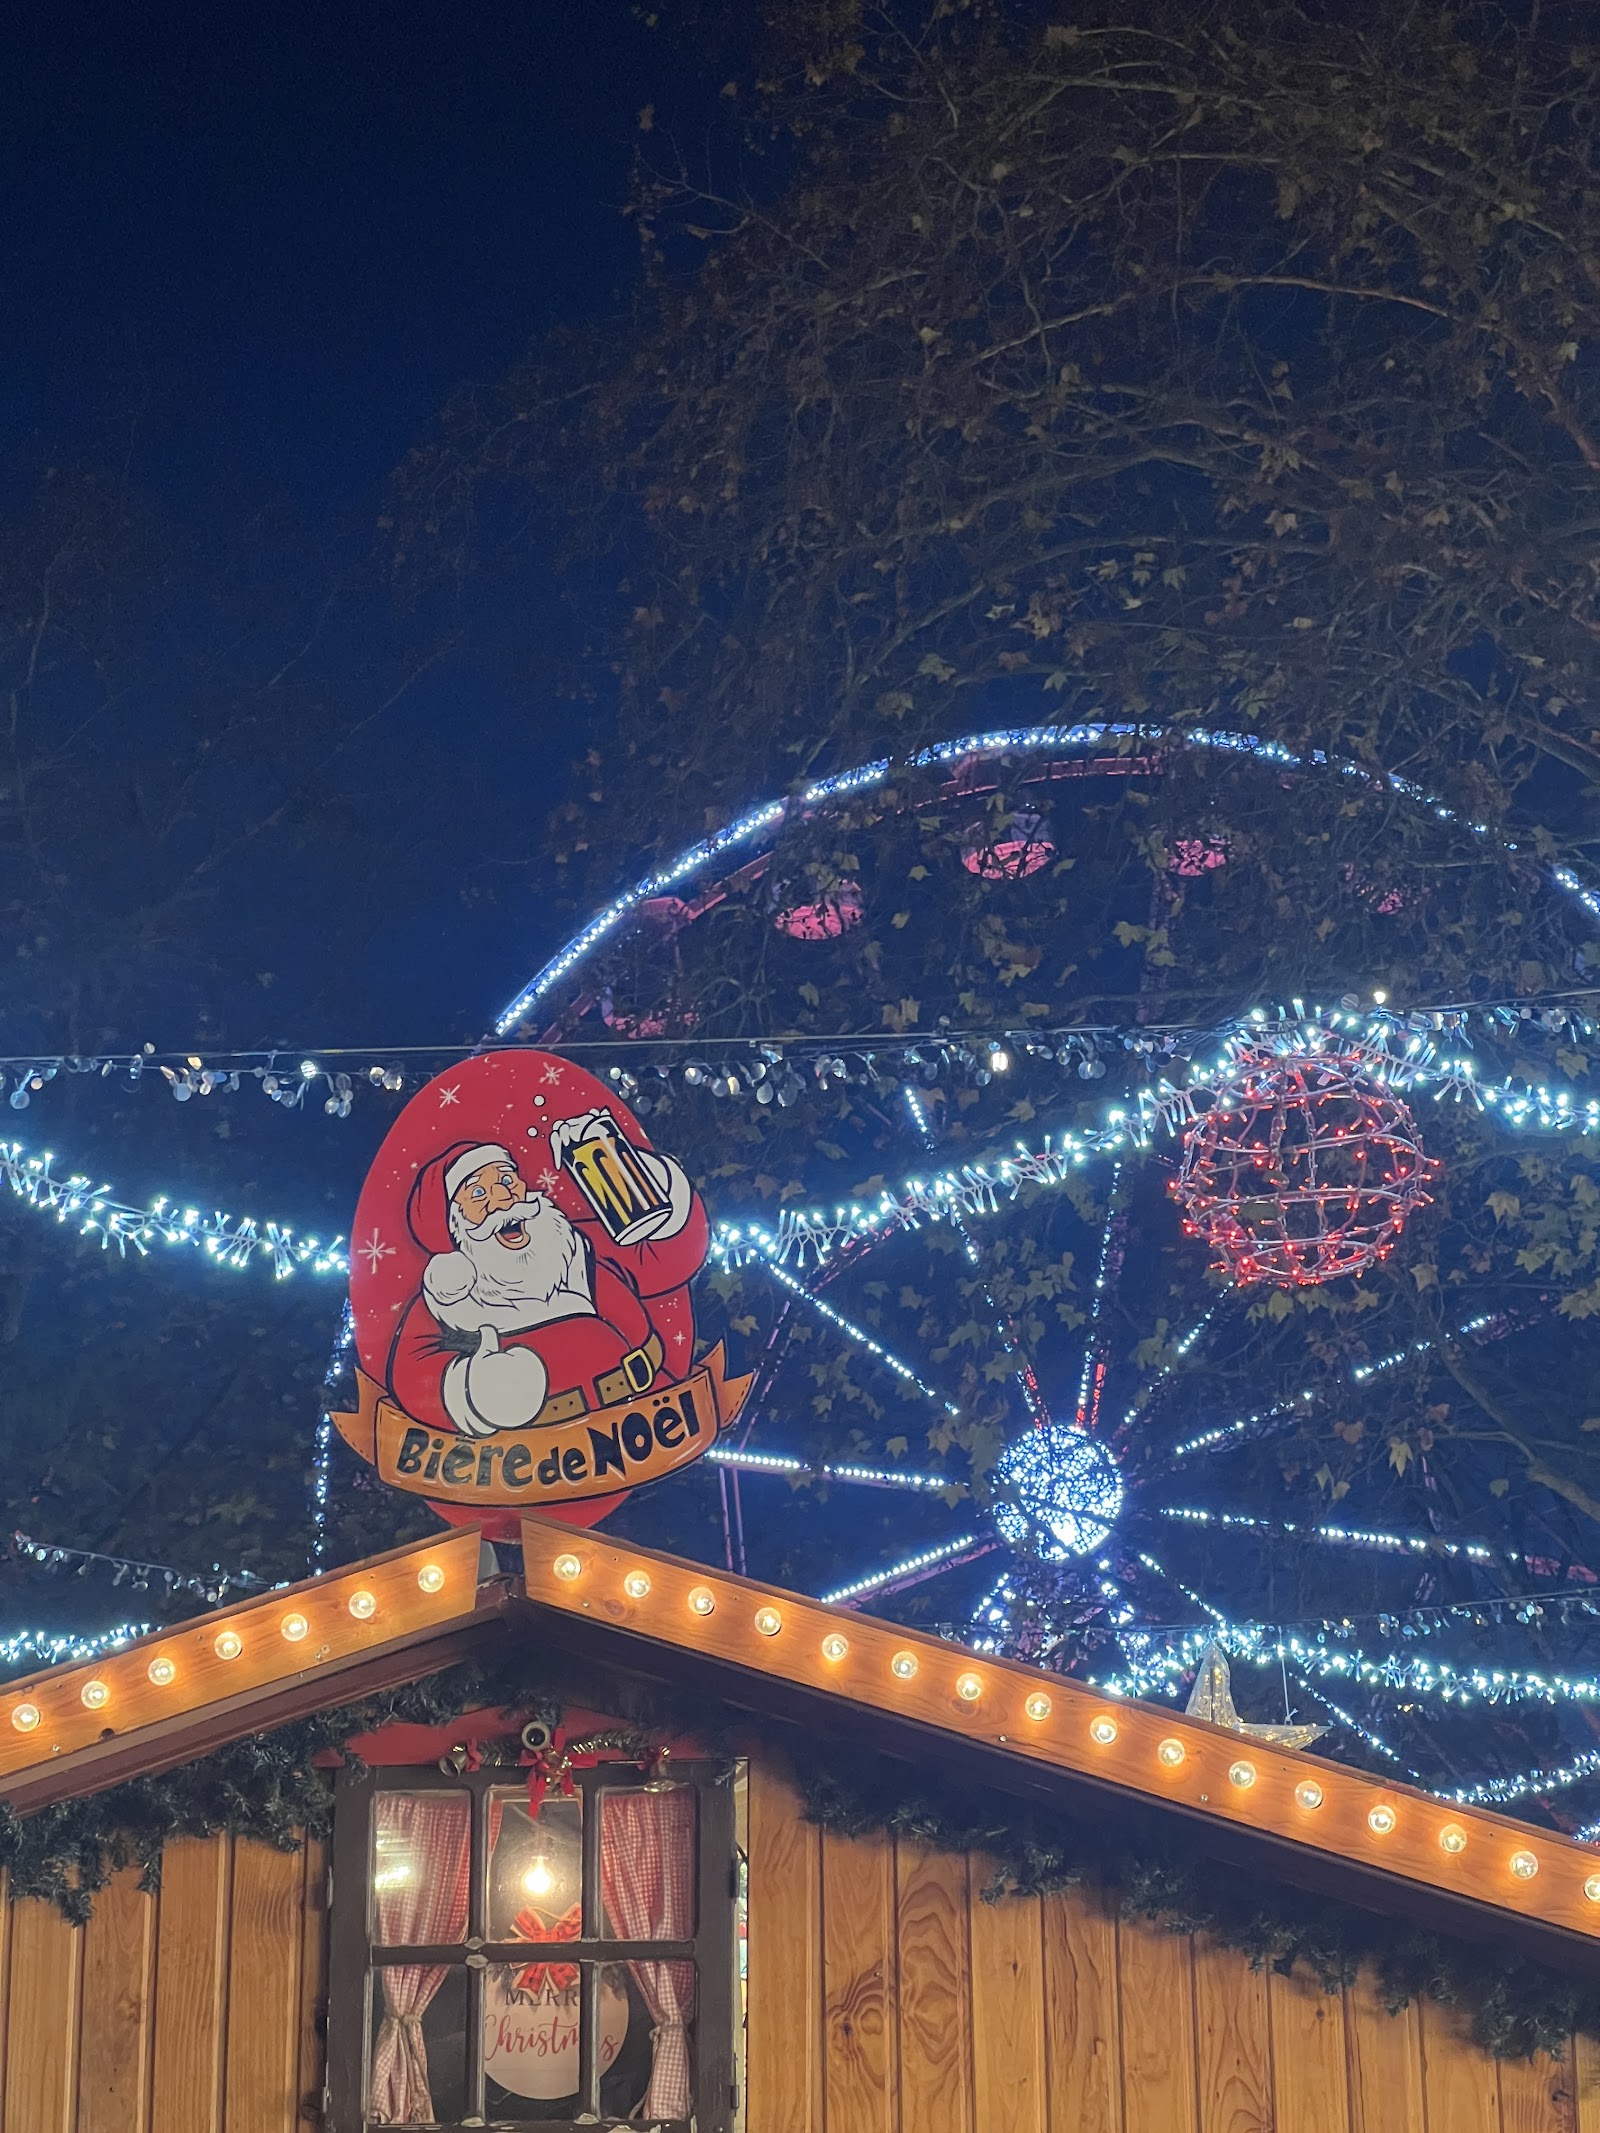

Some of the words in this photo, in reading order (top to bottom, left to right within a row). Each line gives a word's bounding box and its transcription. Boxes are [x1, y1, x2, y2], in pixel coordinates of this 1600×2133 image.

[396, 1427, 533, 1487] Bière
[537, 1446, 588, 1485] de
[484, 2013, 620, 2062] Christms
